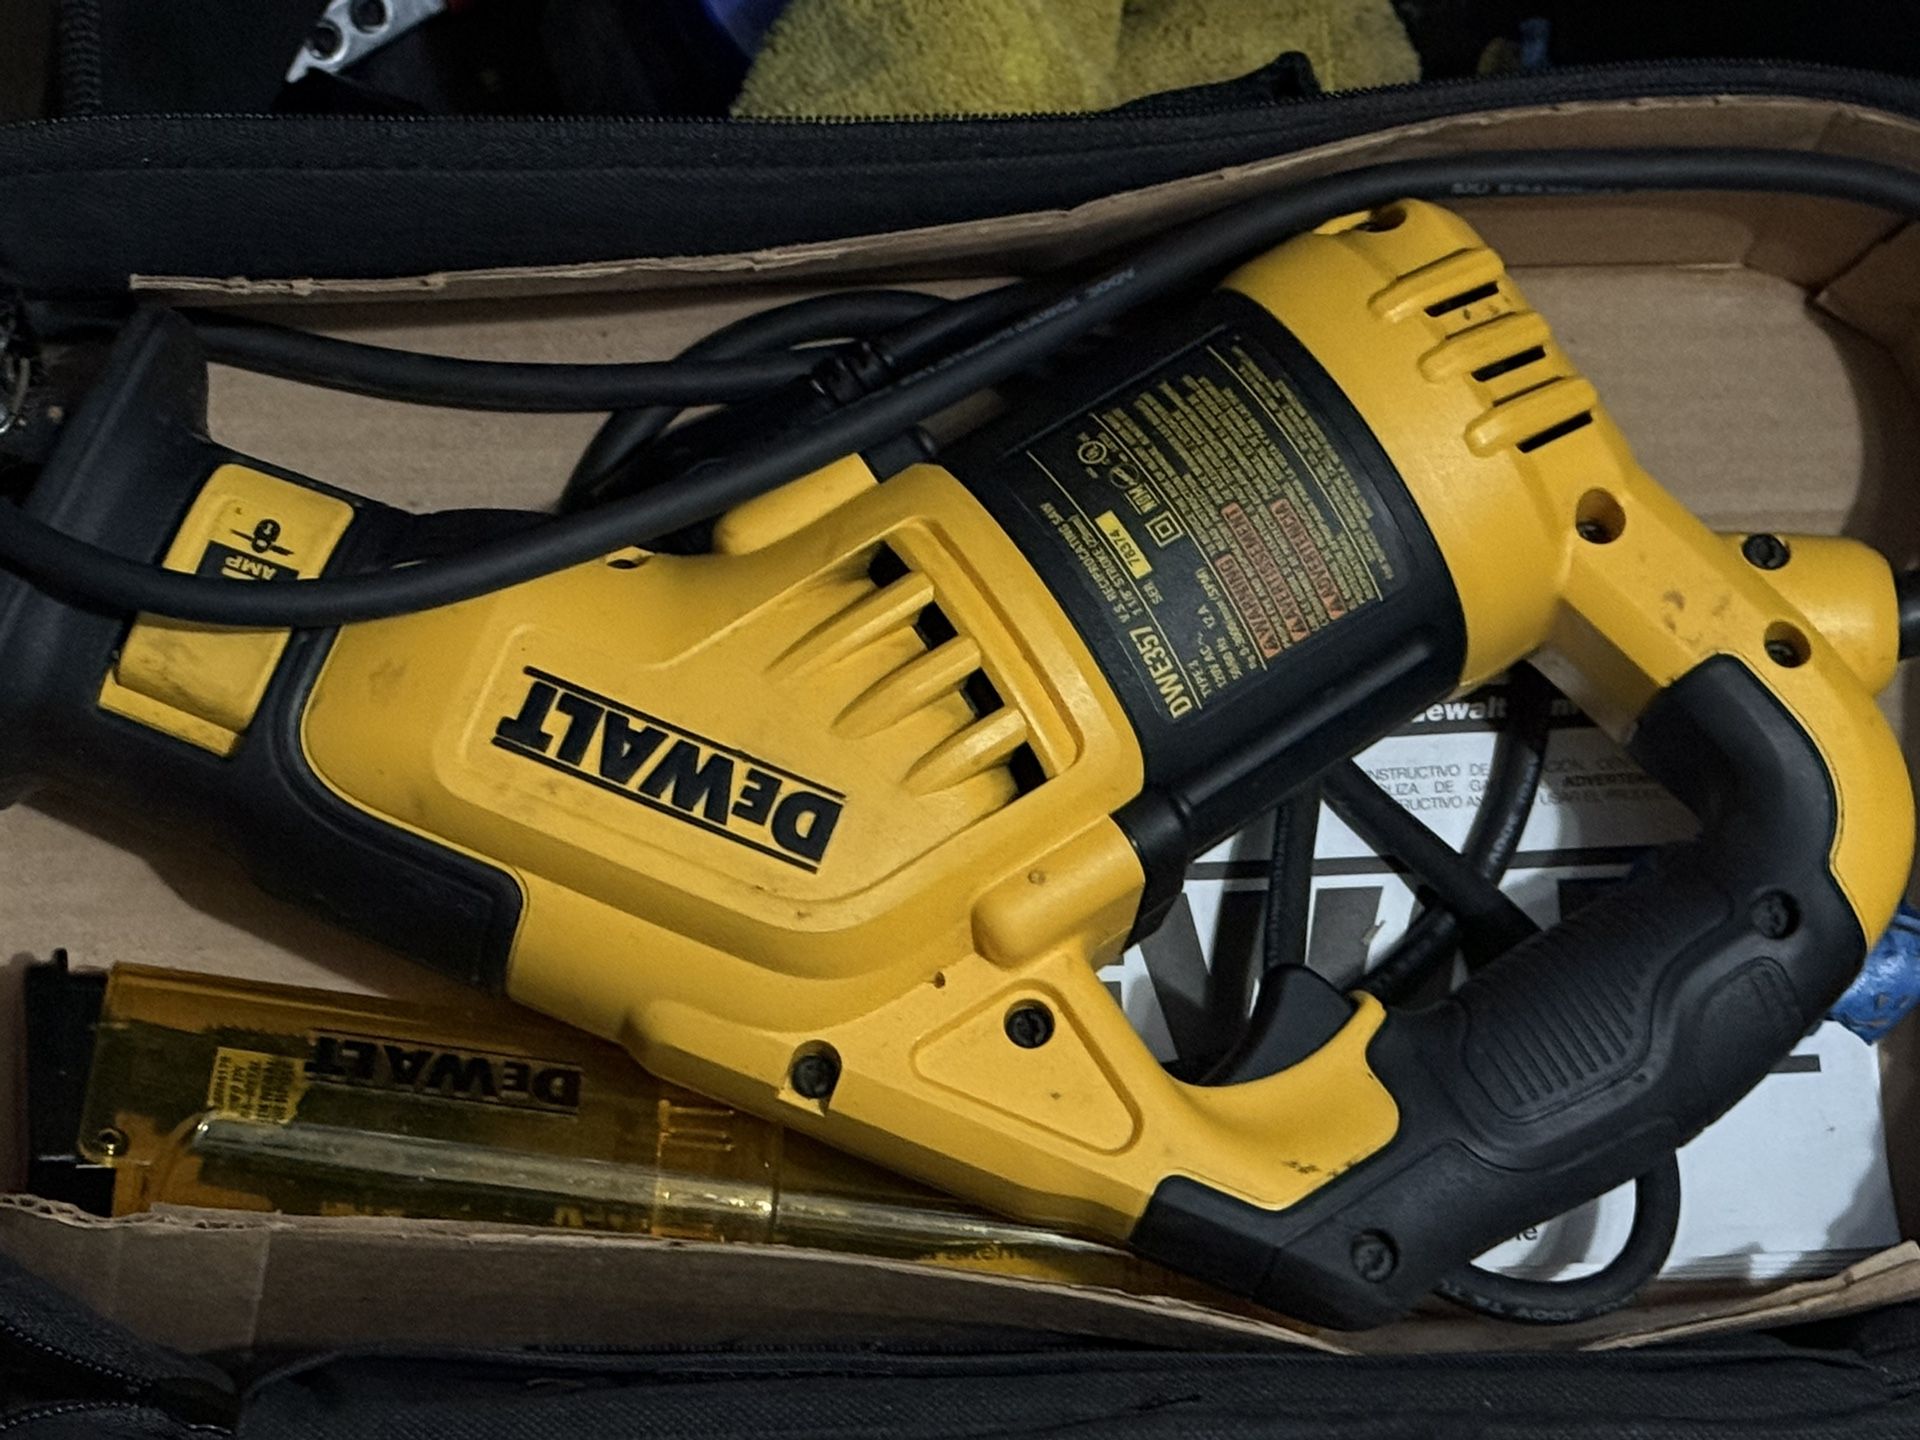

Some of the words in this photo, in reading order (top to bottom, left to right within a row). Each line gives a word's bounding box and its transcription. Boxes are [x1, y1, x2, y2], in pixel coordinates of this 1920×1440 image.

[1127, 483, 1157, 512] NOM
[1039, 500, 1064, 526] SAW
[1057, 522, 1118, 601] RECIPROCATING
[1108, 528, 1141, 566] 78374
[1271, 500, 1337, 600] ADVERTENCIA
[224, 555, 278, 581] AMP
[1092, 546, 1124, 588] STROKE
[1223, 507, 1299, 621] AVERTISSEMENT
[1216, 557, 1271, 639] WARNING
[1198, 644, 1216, 663] AC
[1128, 621, 1194, 718] DWE357
[1191, 668, 1214, 698] TYPE
[1207, 661, 1228, 688] 120V
[1411, 698, 1506, 723] ewalt
[495, 681, 845, 862] DEWALT
[1367, 764, 1461, 782] NSTRUCTIVO
[1433, 780, 1455, 794] DE
